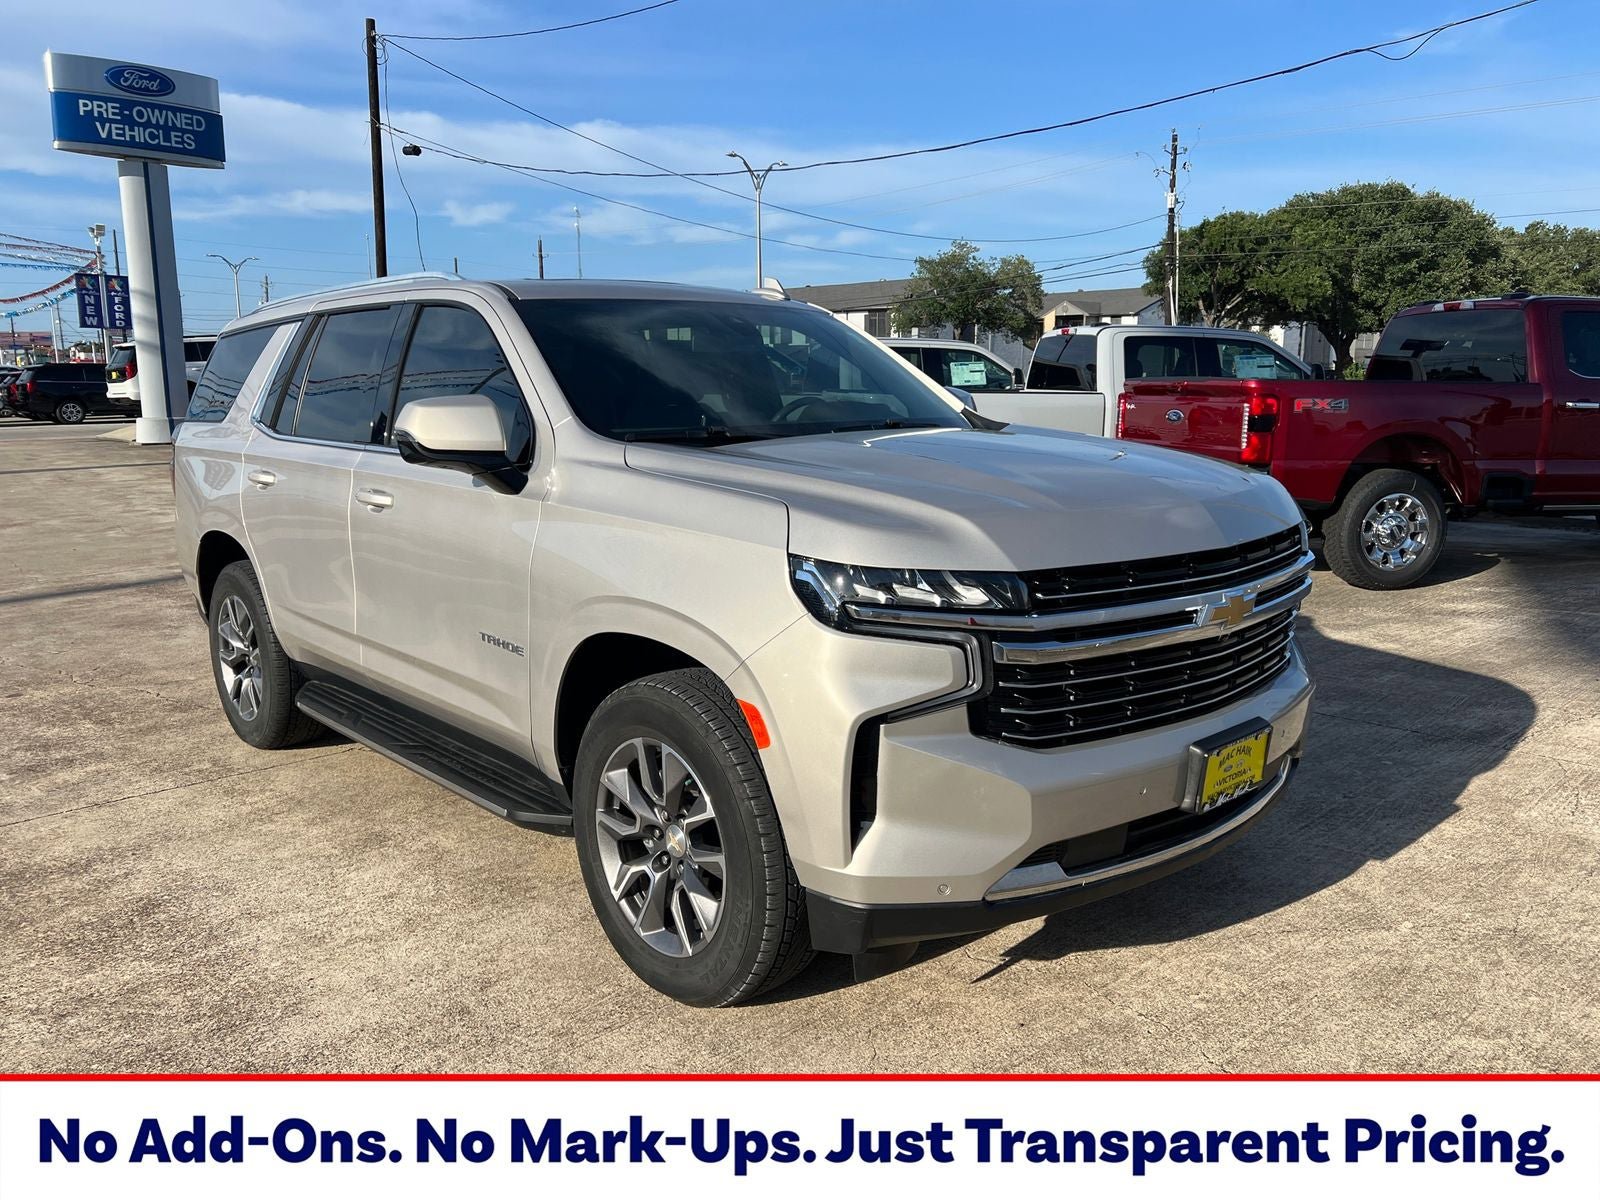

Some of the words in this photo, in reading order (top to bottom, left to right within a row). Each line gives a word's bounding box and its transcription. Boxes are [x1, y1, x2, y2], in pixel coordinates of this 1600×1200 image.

[120, 69, 160, 91] Ford
[95, 121, 196, 150] VEHICLES
[84, 295, 98, 326] NEW
[113, 297, 126, 327] FORD
[1294, 398, 1348, 412] FX4
[479, 632, 524, 657] TAHOE
